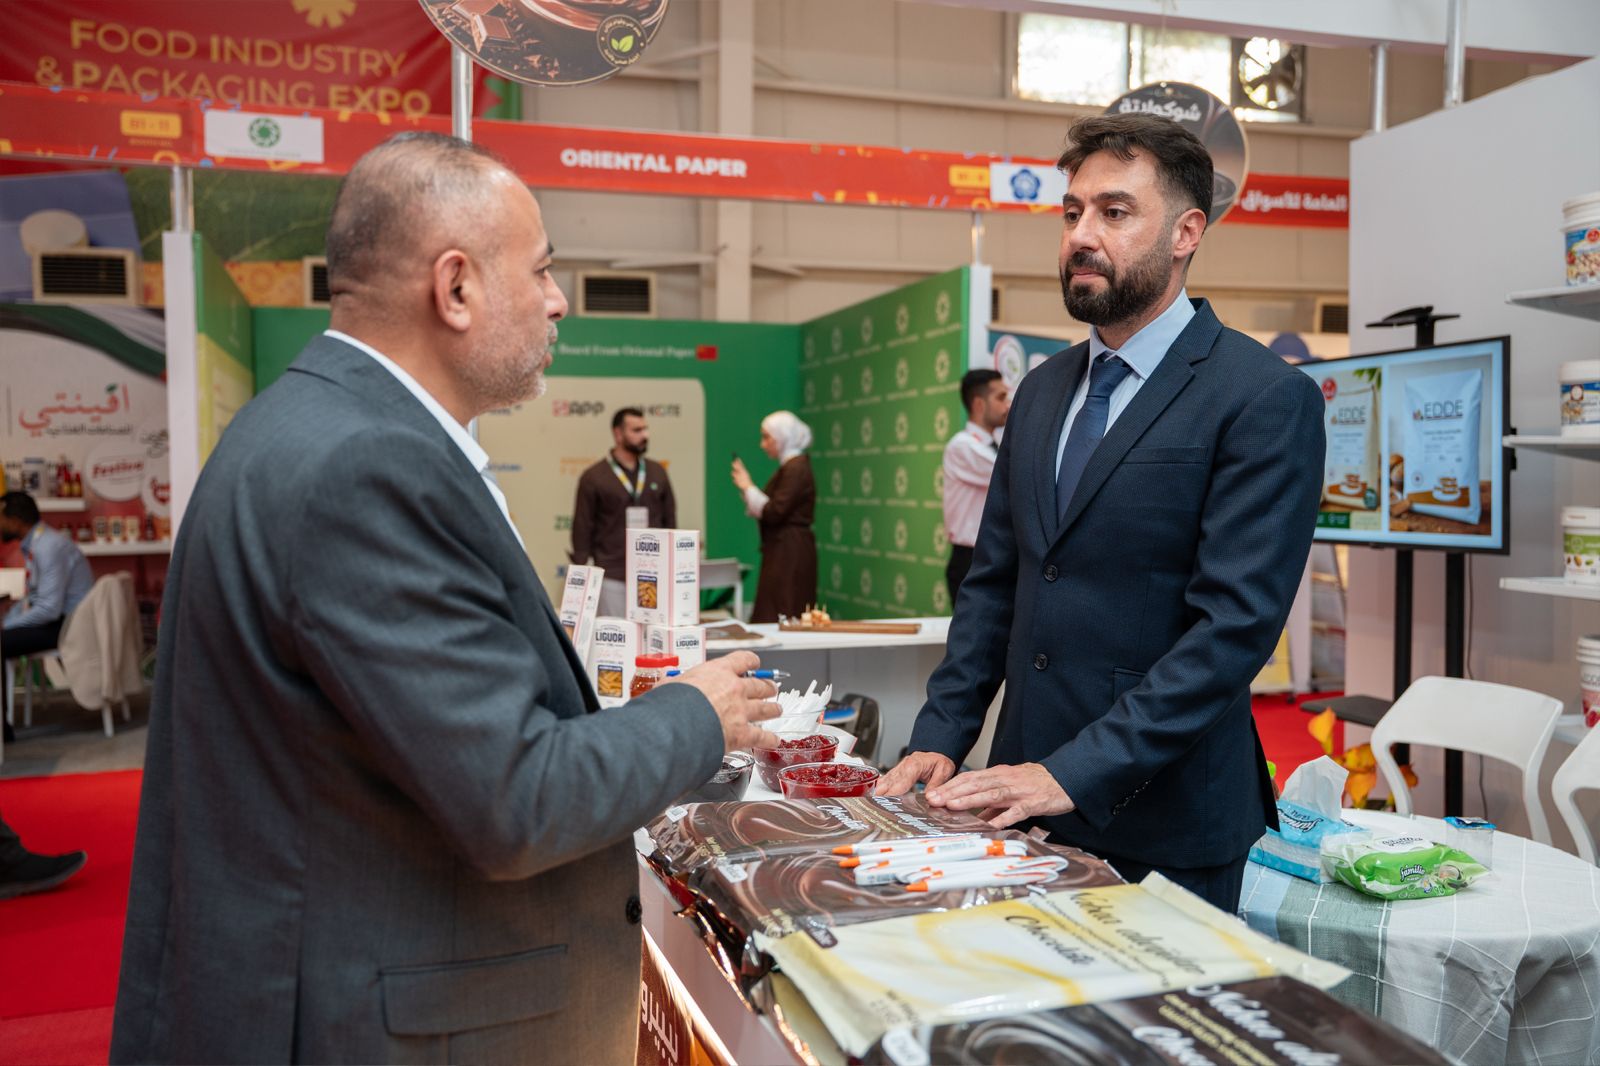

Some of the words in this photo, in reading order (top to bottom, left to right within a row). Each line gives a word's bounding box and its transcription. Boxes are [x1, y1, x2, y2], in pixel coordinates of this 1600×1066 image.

[70, 20, 197, 60] FOOD
[210, 35, 407, 78] INDUSTRY
[35, 55, 63, 87] &
[73, 60, 316, 108] PACKAGING
[327, 84, 431, 117] EXPO
[560, 148, 672, 173] ORIENTAL
[675, 155, 748, 178] PAPER
[635, 541, 660, 553] LIGUORI
[676, 541, 695, 549] LIGUORI
[595, 631, 626, 643] LIGUORI
[675, 639, 700, 648] LIGUORI
[1005, 915, 1095, 965] Chocolate
